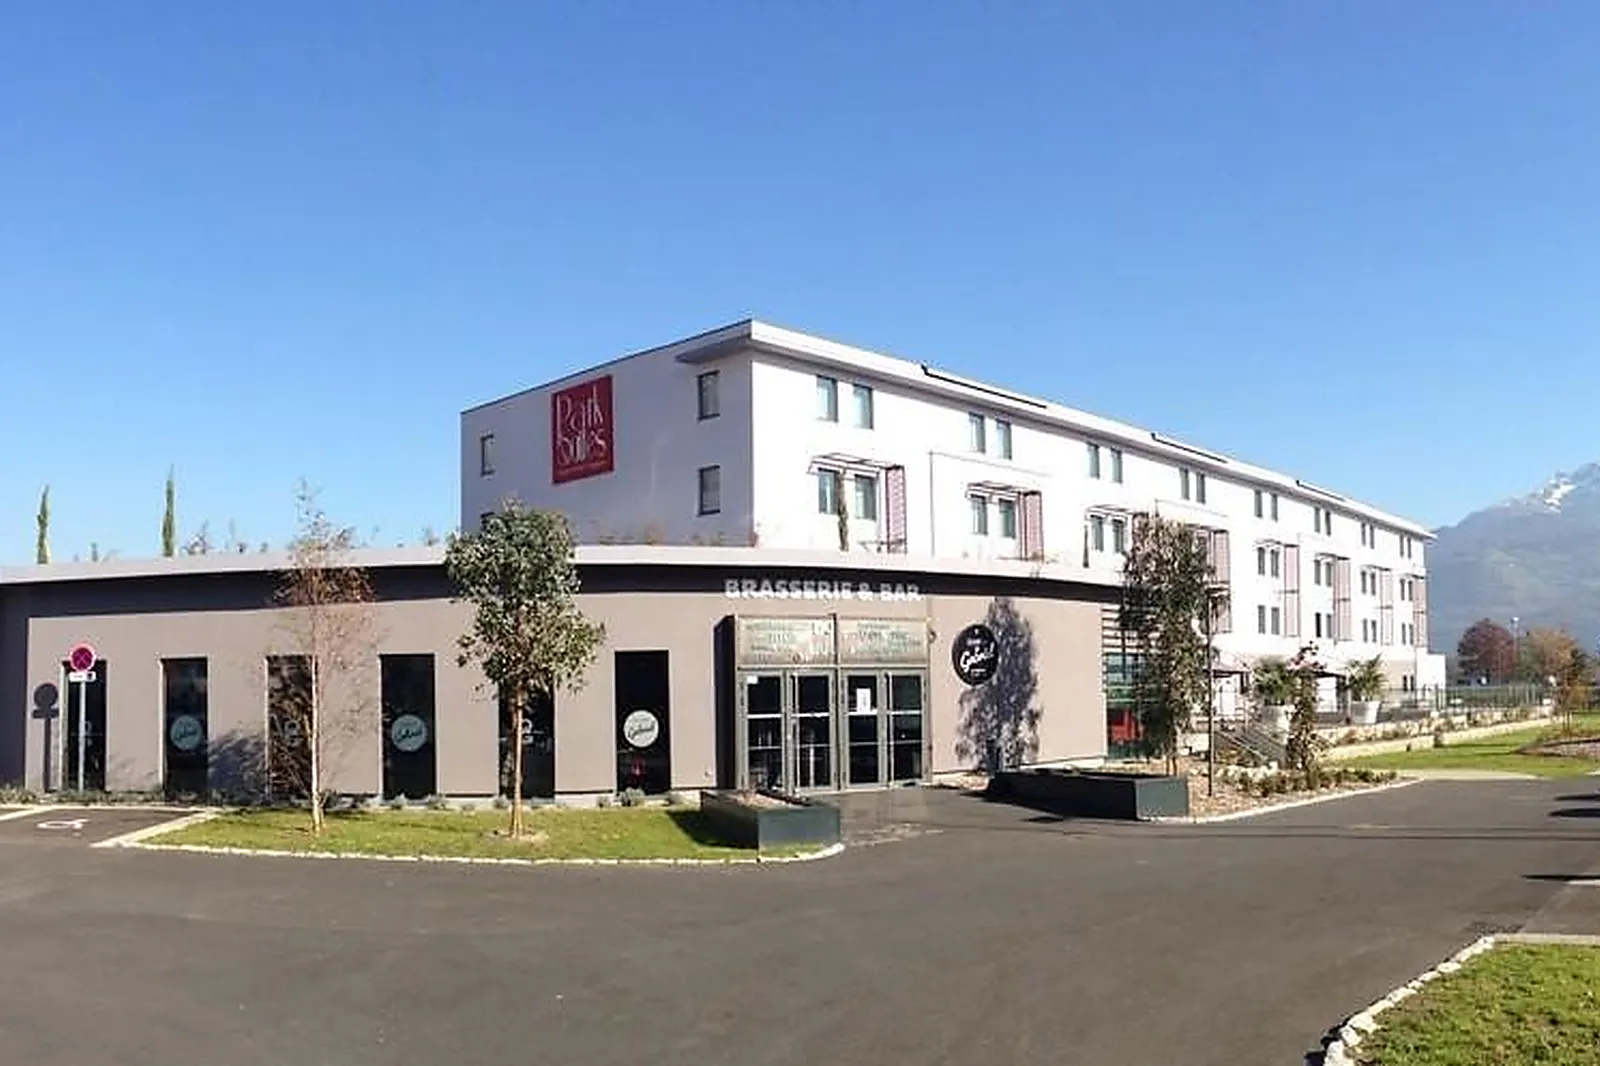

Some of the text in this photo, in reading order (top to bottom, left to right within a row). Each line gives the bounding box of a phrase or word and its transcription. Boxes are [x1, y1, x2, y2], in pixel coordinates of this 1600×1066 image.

[724, 579, 921, 601] BRASSERIE & BAR
